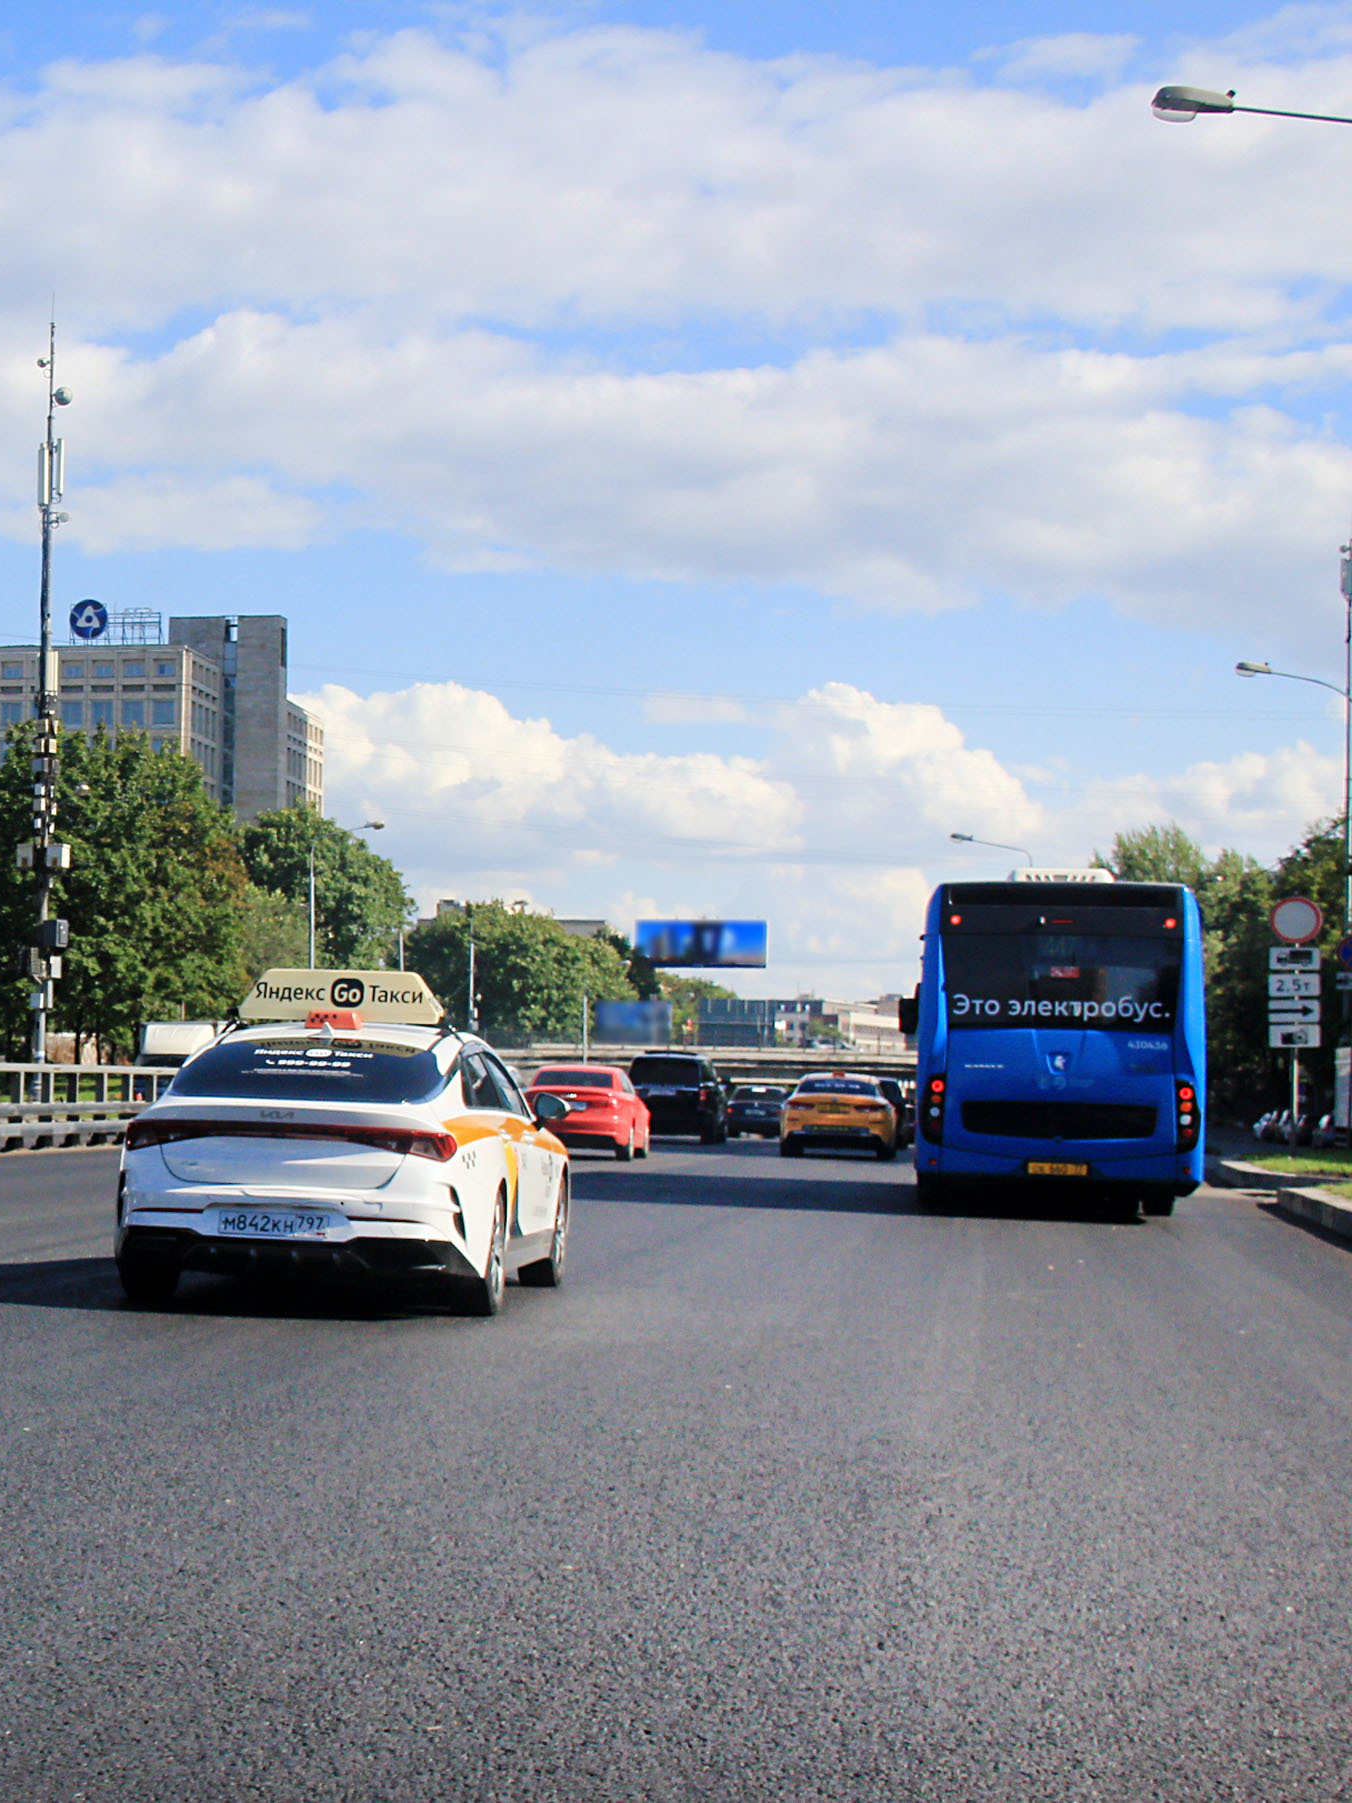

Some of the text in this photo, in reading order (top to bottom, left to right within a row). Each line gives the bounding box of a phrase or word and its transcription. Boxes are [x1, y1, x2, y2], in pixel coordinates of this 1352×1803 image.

[255, 982, 423, 1004] Яндекс Go Такси
[952, 993, 1171, 1023] Это электробус.
[297, 1215, 324, 1231] 797
